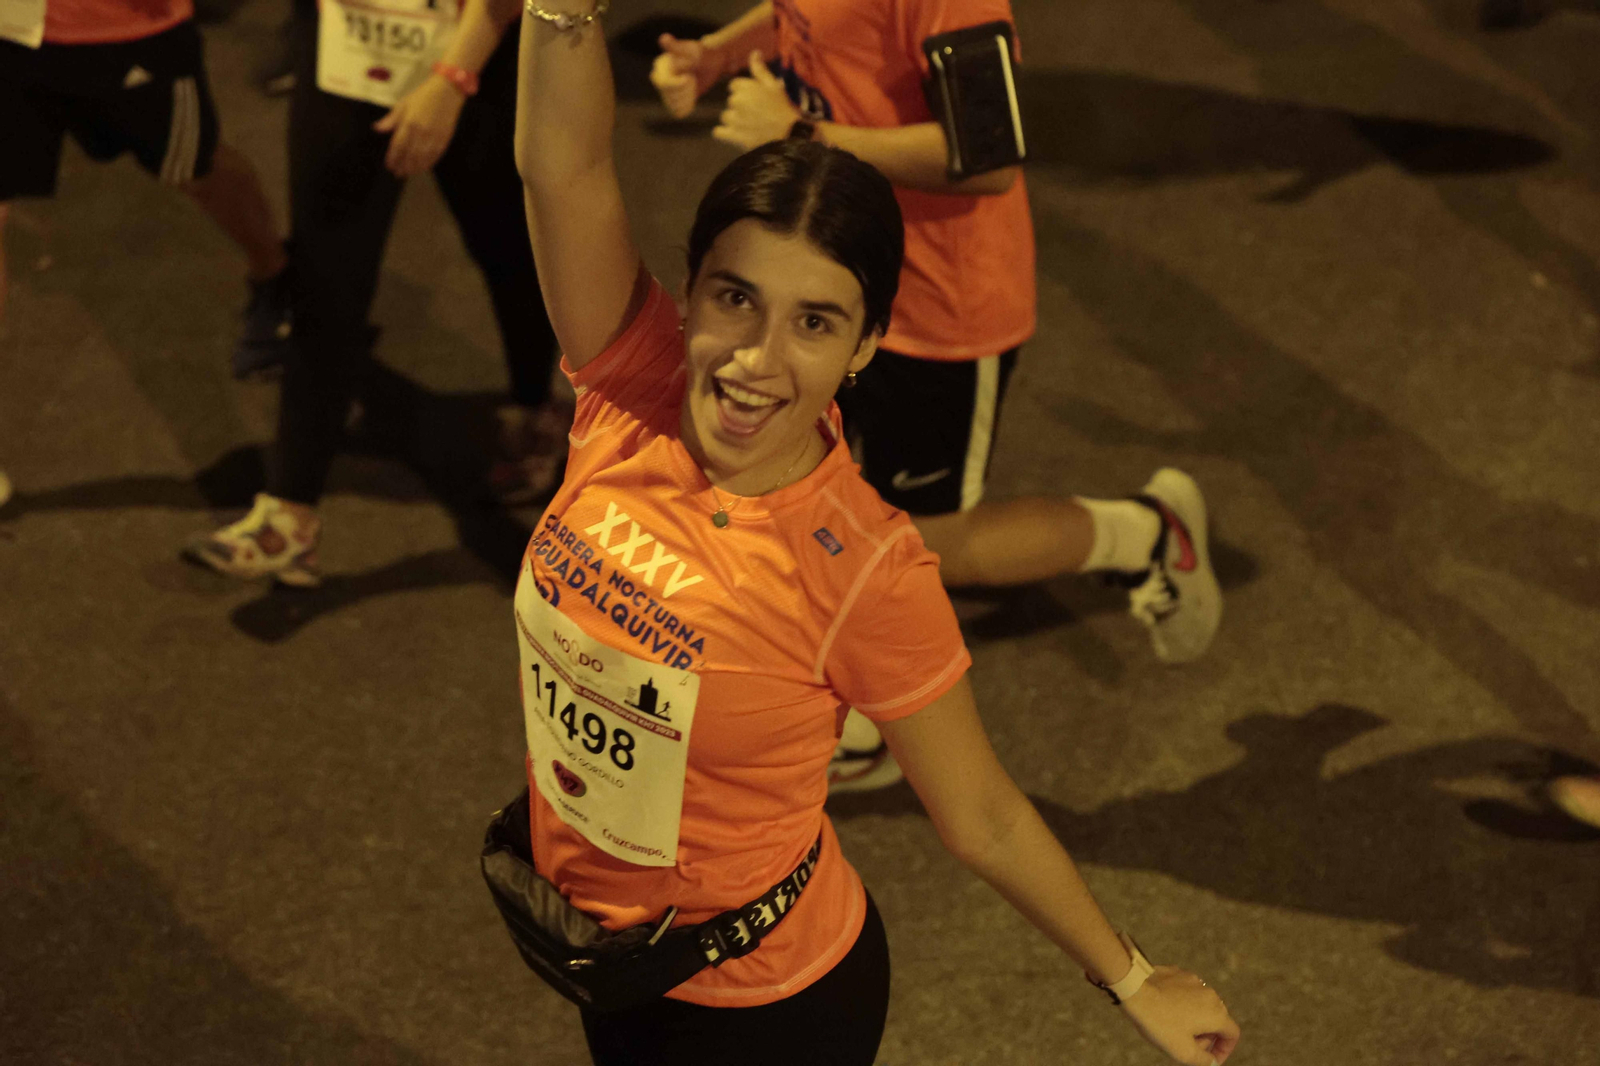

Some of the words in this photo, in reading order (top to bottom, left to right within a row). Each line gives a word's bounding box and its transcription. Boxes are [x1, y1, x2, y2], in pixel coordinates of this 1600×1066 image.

[545, 514, 604, 575] CARRERA
[608, 570, 706, 655] NOCTURNA
[584, 500, 705, 599] XXXV
[531, 663, 635, 771] 11498
